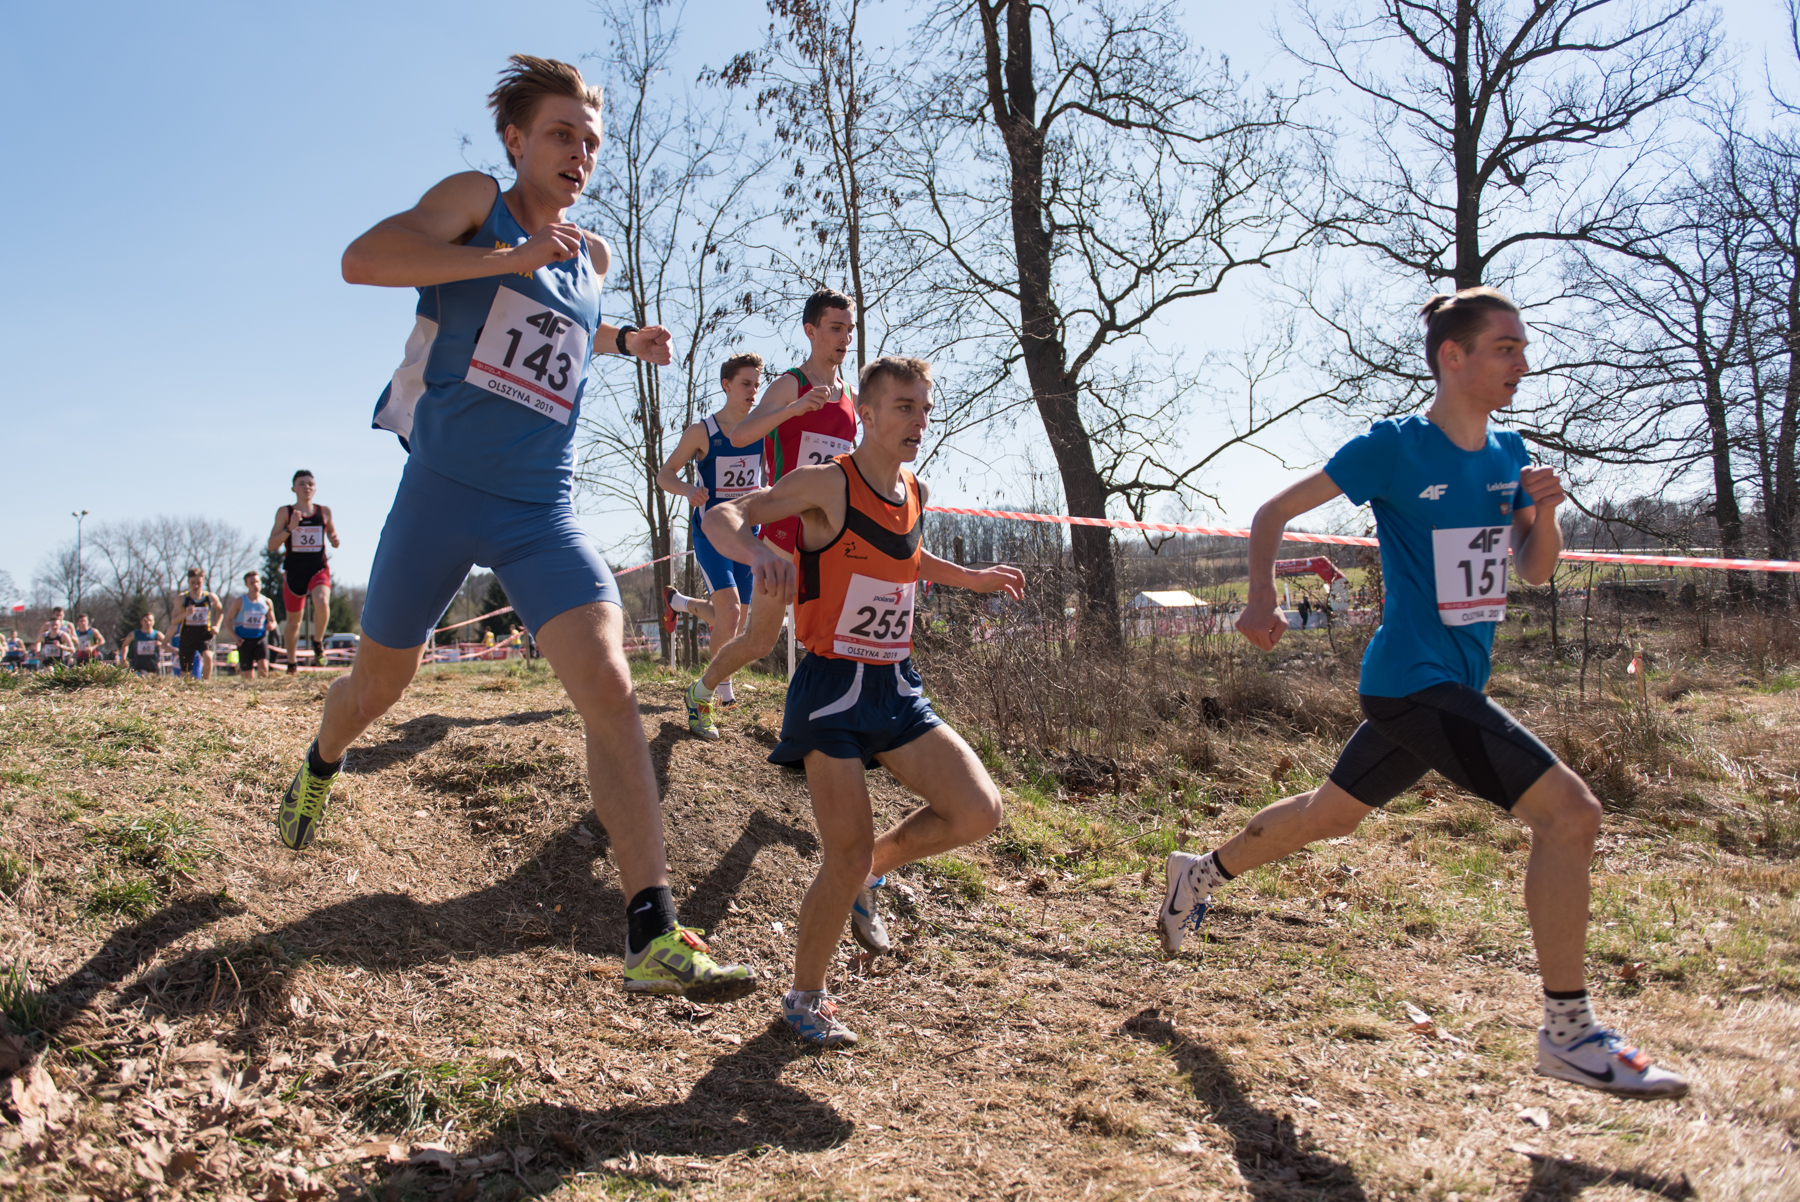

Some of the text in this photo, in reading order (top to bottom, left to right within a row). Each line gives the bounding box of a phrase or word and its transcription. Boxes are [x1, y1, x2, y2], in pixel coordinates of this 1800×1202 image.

[526, 311, 573, 339] 4F
[502, 327, 572, 392] 143
[487, 379, 531, 404] OLSZYNA
[534, 399, 554, 414] 2019
[723, 468, 755, 487] 262
[1418, 484, 1449, 501] 4F
[300, 534, 316, 545] 36
[1468, 527, 1505, 553] 4F
[1457, 557, 1508, 598] 151
[873, 595, 896, 604] polanik
[192, 613, 204, 621] 65
[849, 605, 911, 640] 255
[847, 646, 898, 659] OLSZYNA 2019
